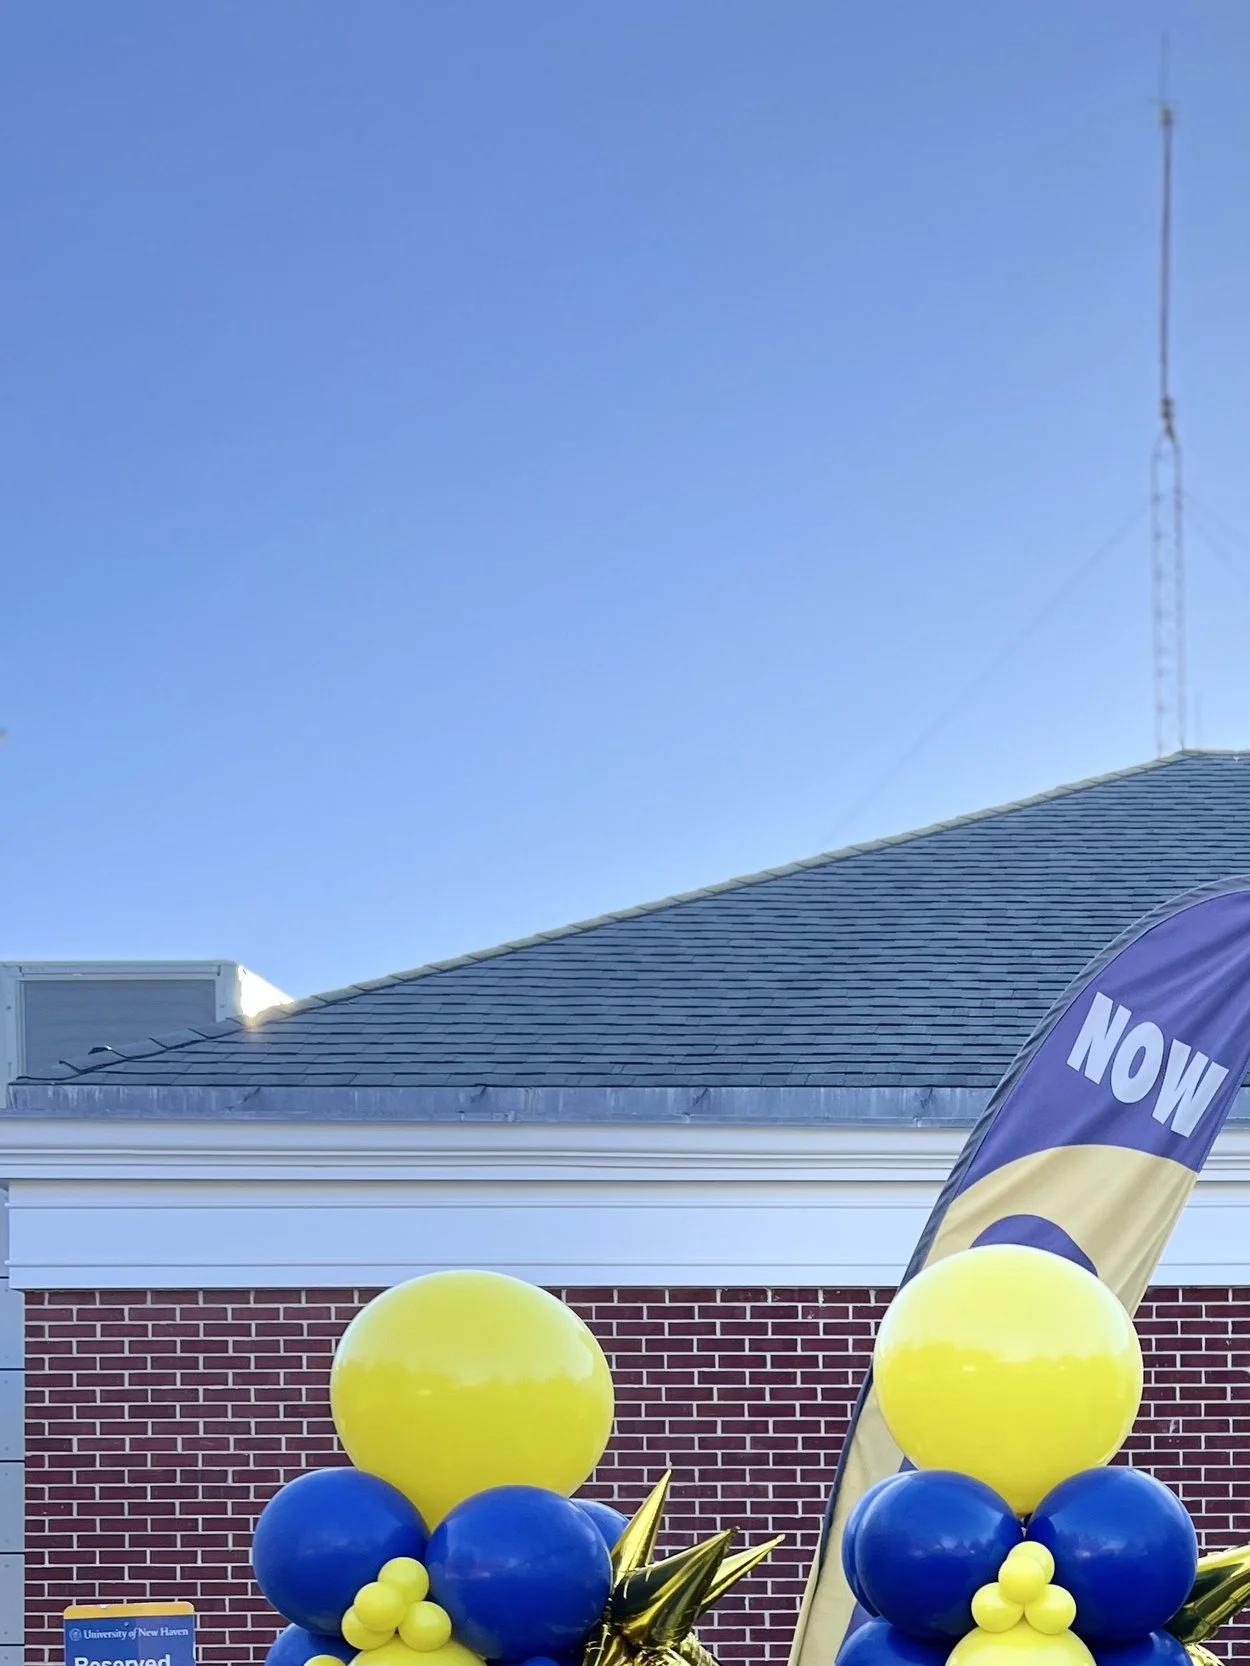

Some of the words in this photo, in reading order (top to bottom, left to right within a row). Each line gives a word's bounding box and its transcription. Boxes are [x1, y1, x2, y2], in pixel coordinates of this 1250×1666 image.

[1066, 991, 1229, 1138] NOW
[83, 1628, 126, 1641] University
[129, 1627, 138, 1640] of
[138, 1628, 159, 1638] New
[160, 1627, 189, 1637] Haven
